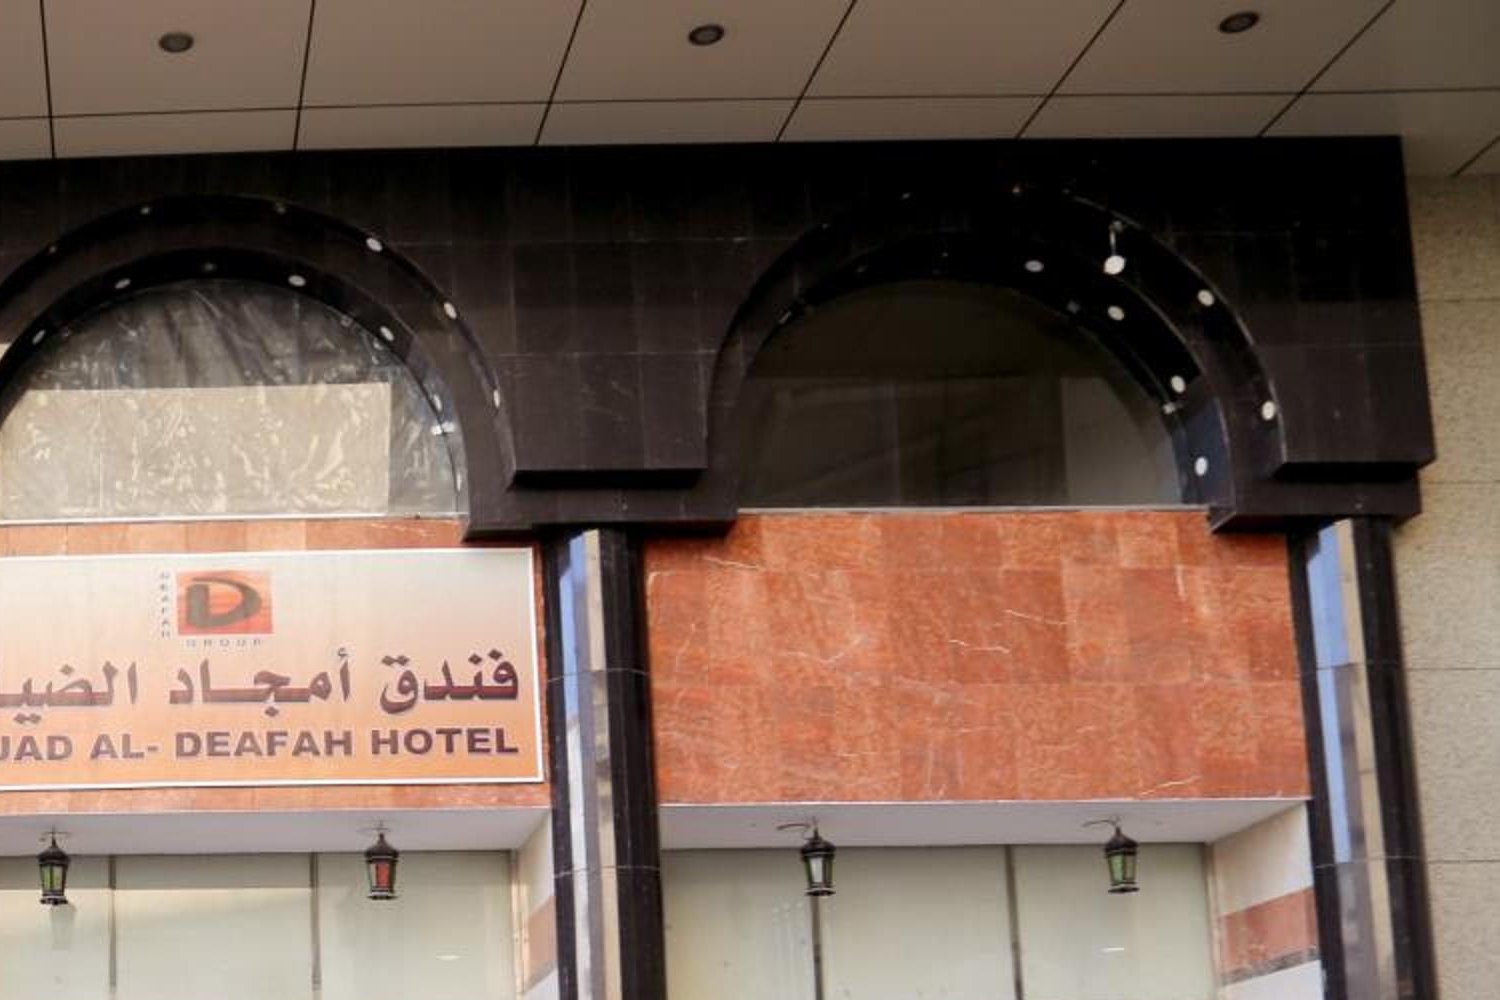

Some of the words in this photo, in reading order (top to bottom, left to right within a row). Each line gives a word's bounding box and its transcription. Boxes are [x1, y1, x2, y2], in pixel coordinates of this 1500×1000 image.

[169, 647, 349, 718] أمجاد
[380, 648, 518, 715] فندق
[90, 733, 159, 760] AL-
[175, 730, 353, 758] DEAFAH
[371, 727, 519, 756] HOTEL
